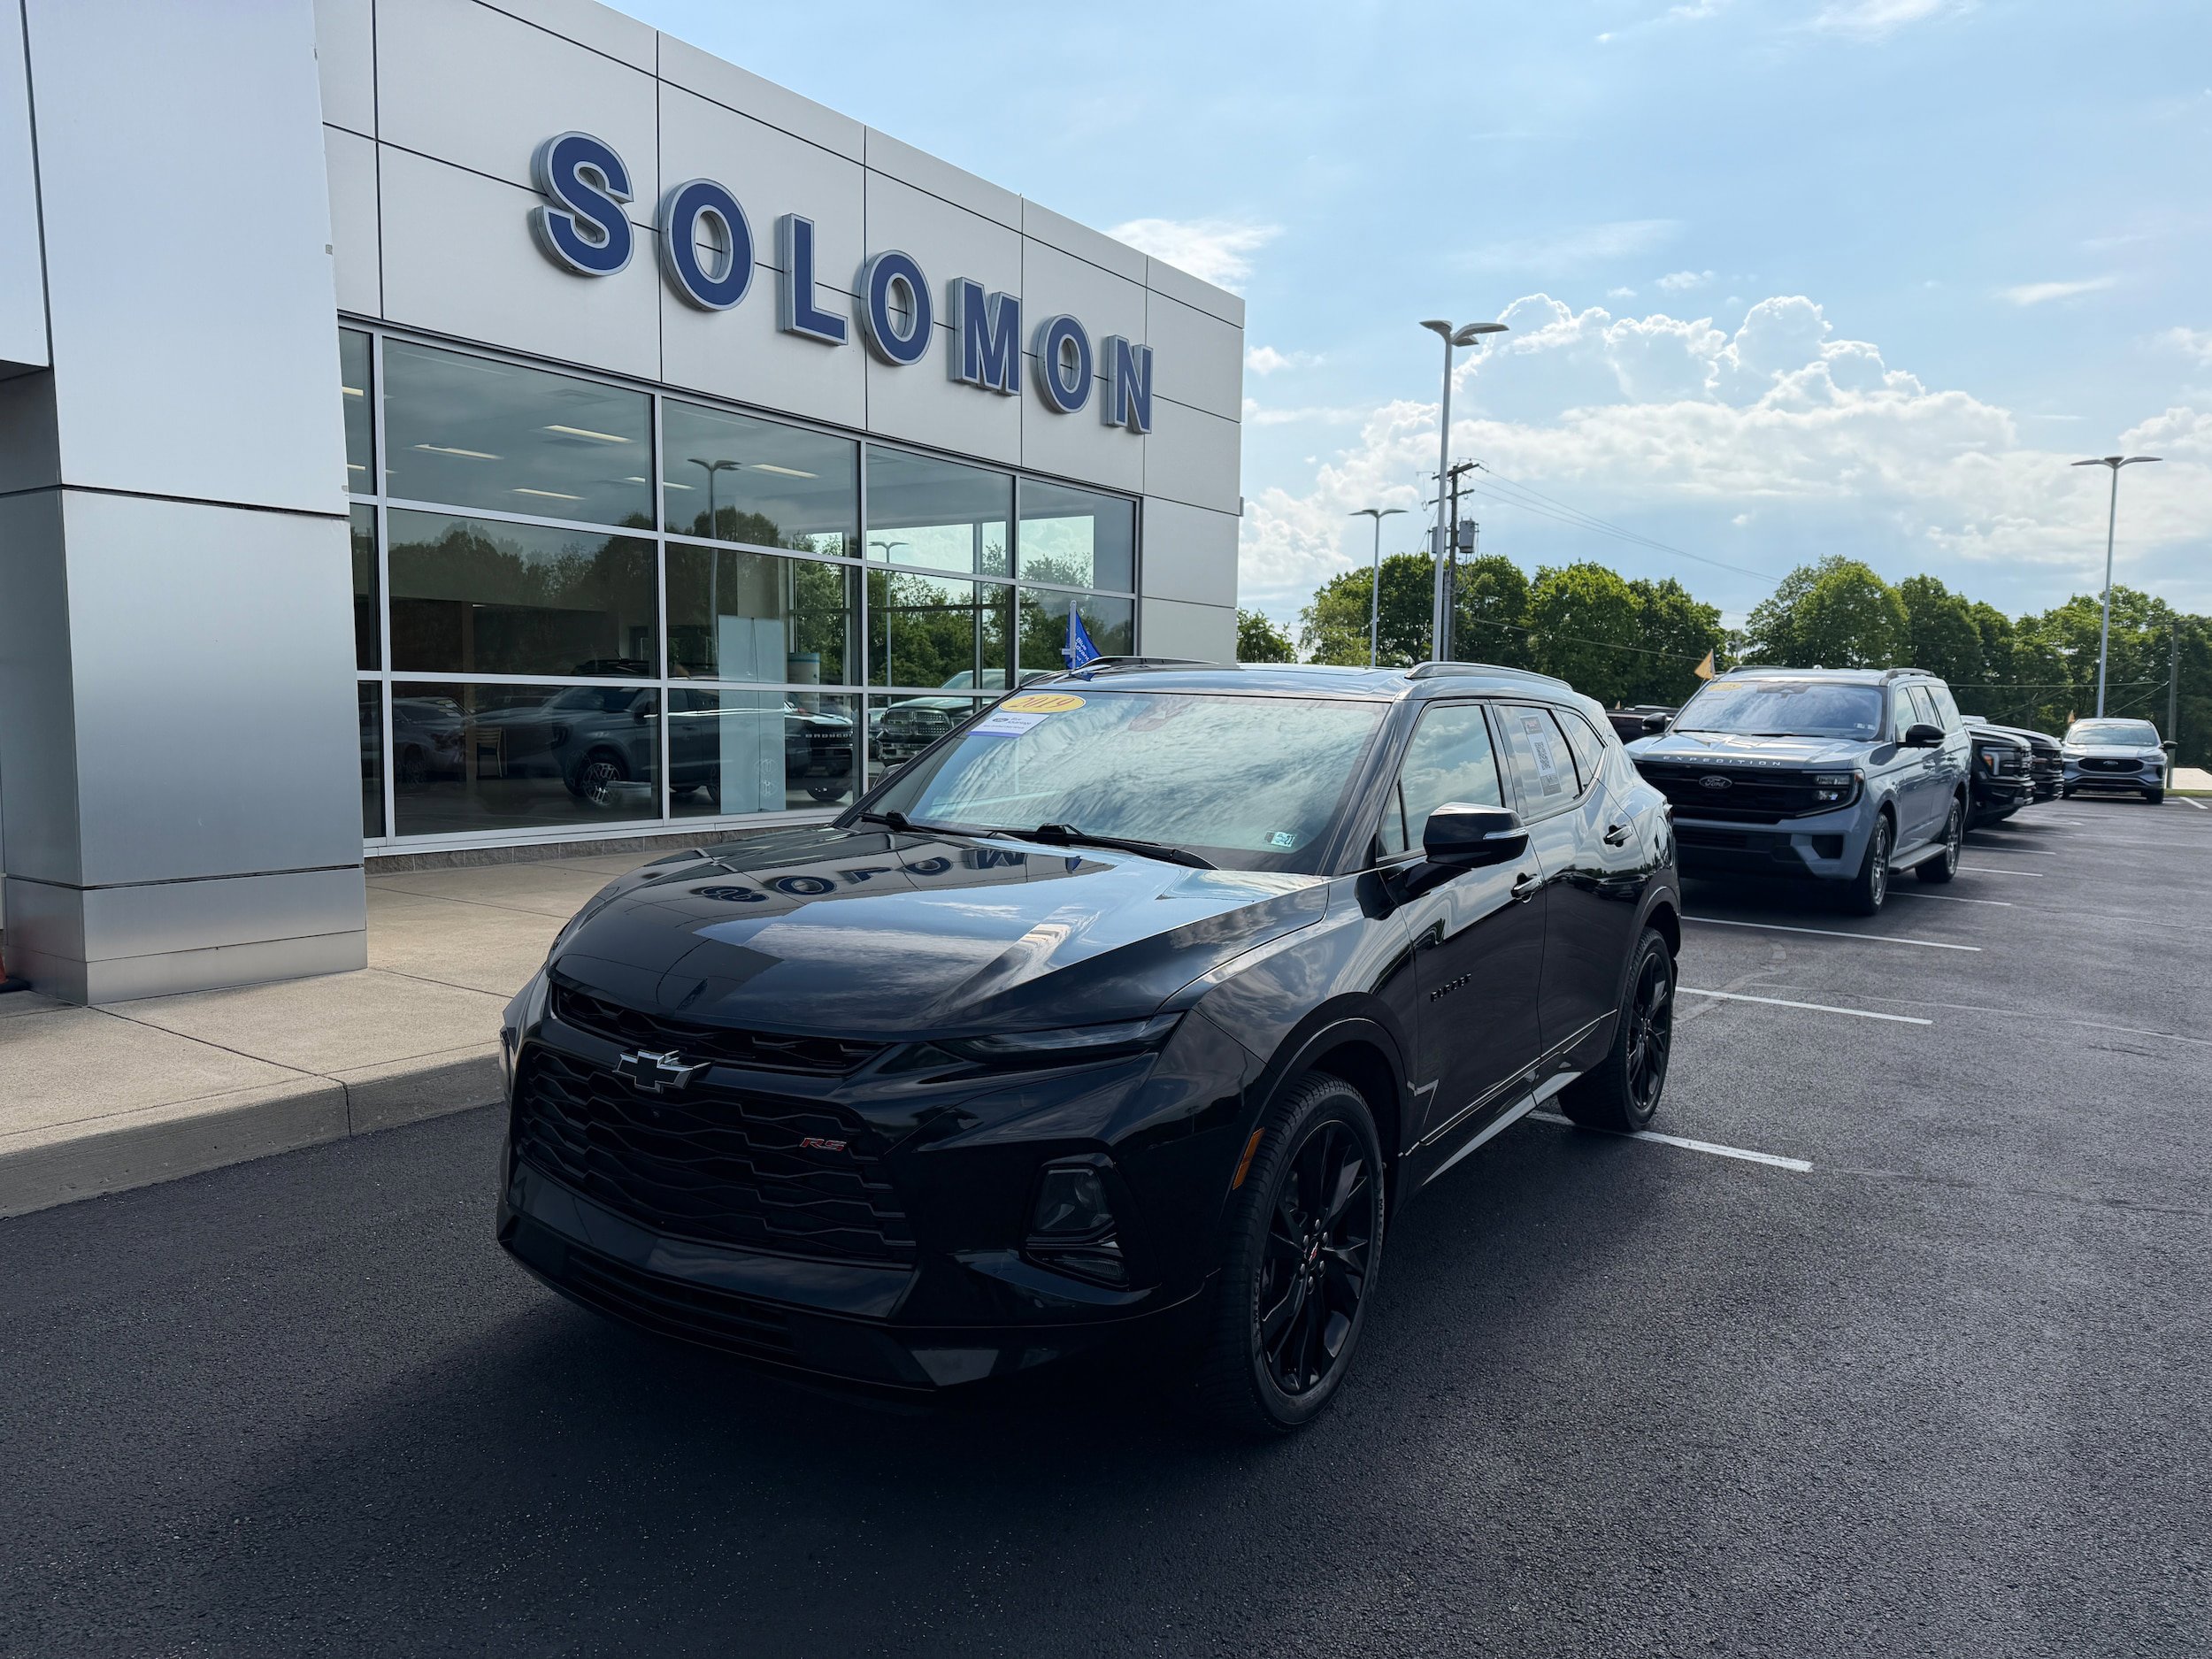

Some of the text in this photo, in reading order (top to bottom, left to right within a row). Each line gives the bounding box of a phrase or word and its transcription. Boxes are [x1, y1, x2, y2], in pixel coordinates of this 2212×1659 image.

[532, 131, 1153, 434] SOLOMON
[1076, 637, 1087, 650] Blue
[1007, 697, 1076, 709] 2019
[1663, 756, 1781, 766] EXPEDITION
[799, 1137, 847, 1151] RS
